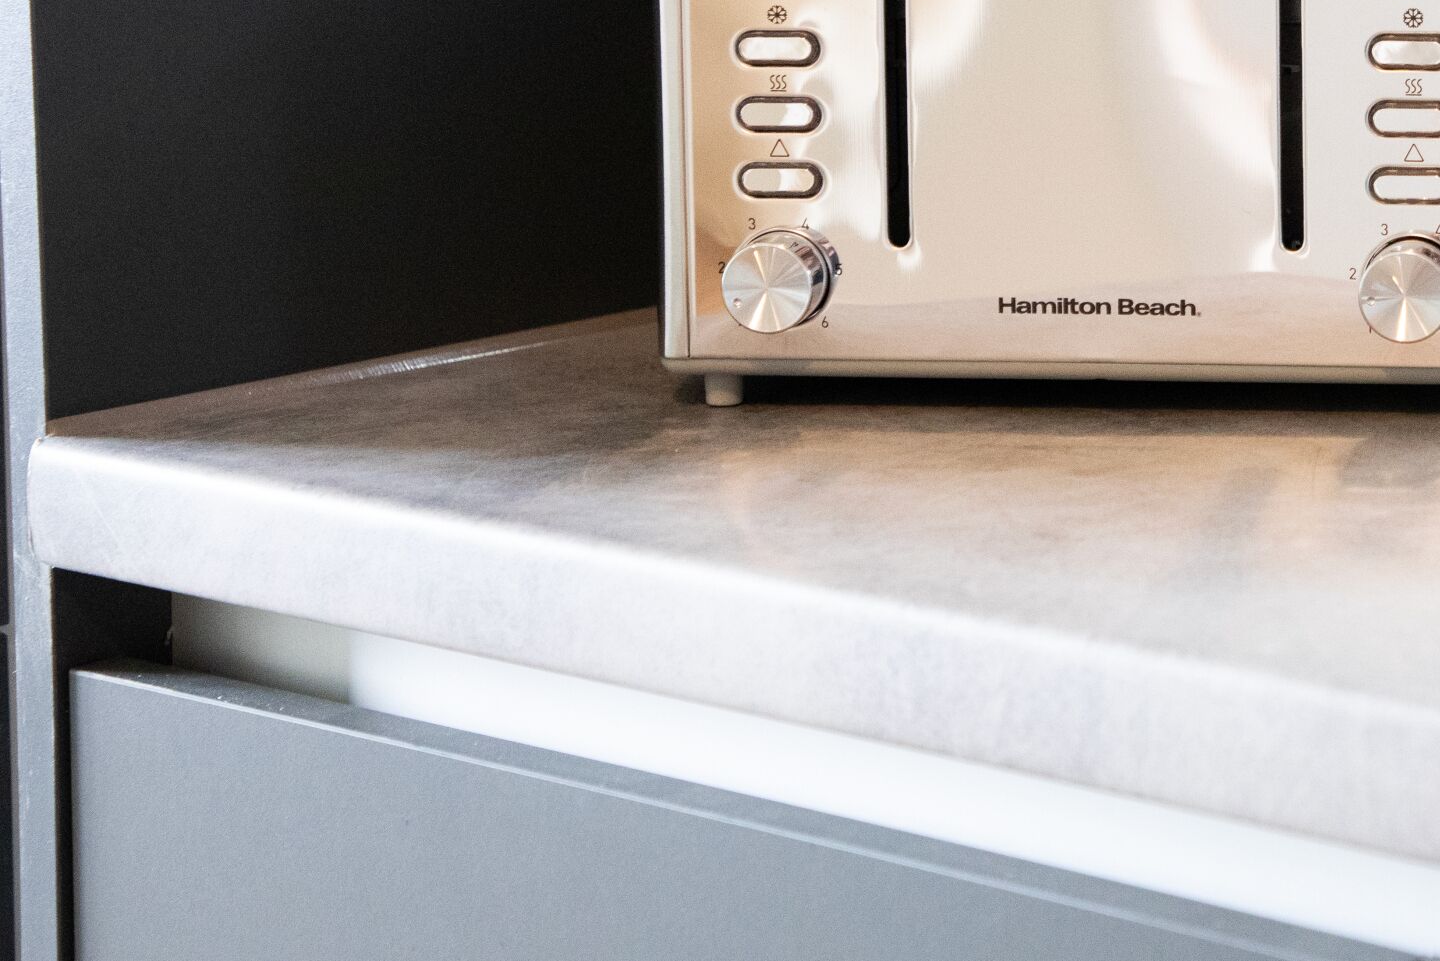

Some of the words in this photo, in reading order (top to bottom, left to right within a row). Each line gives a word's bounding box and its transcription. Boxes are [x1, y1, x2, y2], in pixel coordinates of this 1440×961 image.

[748, 217, 756, 230] 3
[801, 217, 809, 230] 4
[1380, 223, 1388, 236] 3
[718, 261, 726, 274] 2
[835, 263, 843, 276] 5
[1349, 267, 1357, 280] 2
[998, 297, 1111, 315] Hamilton
[821, 316, 829, 328] 6
